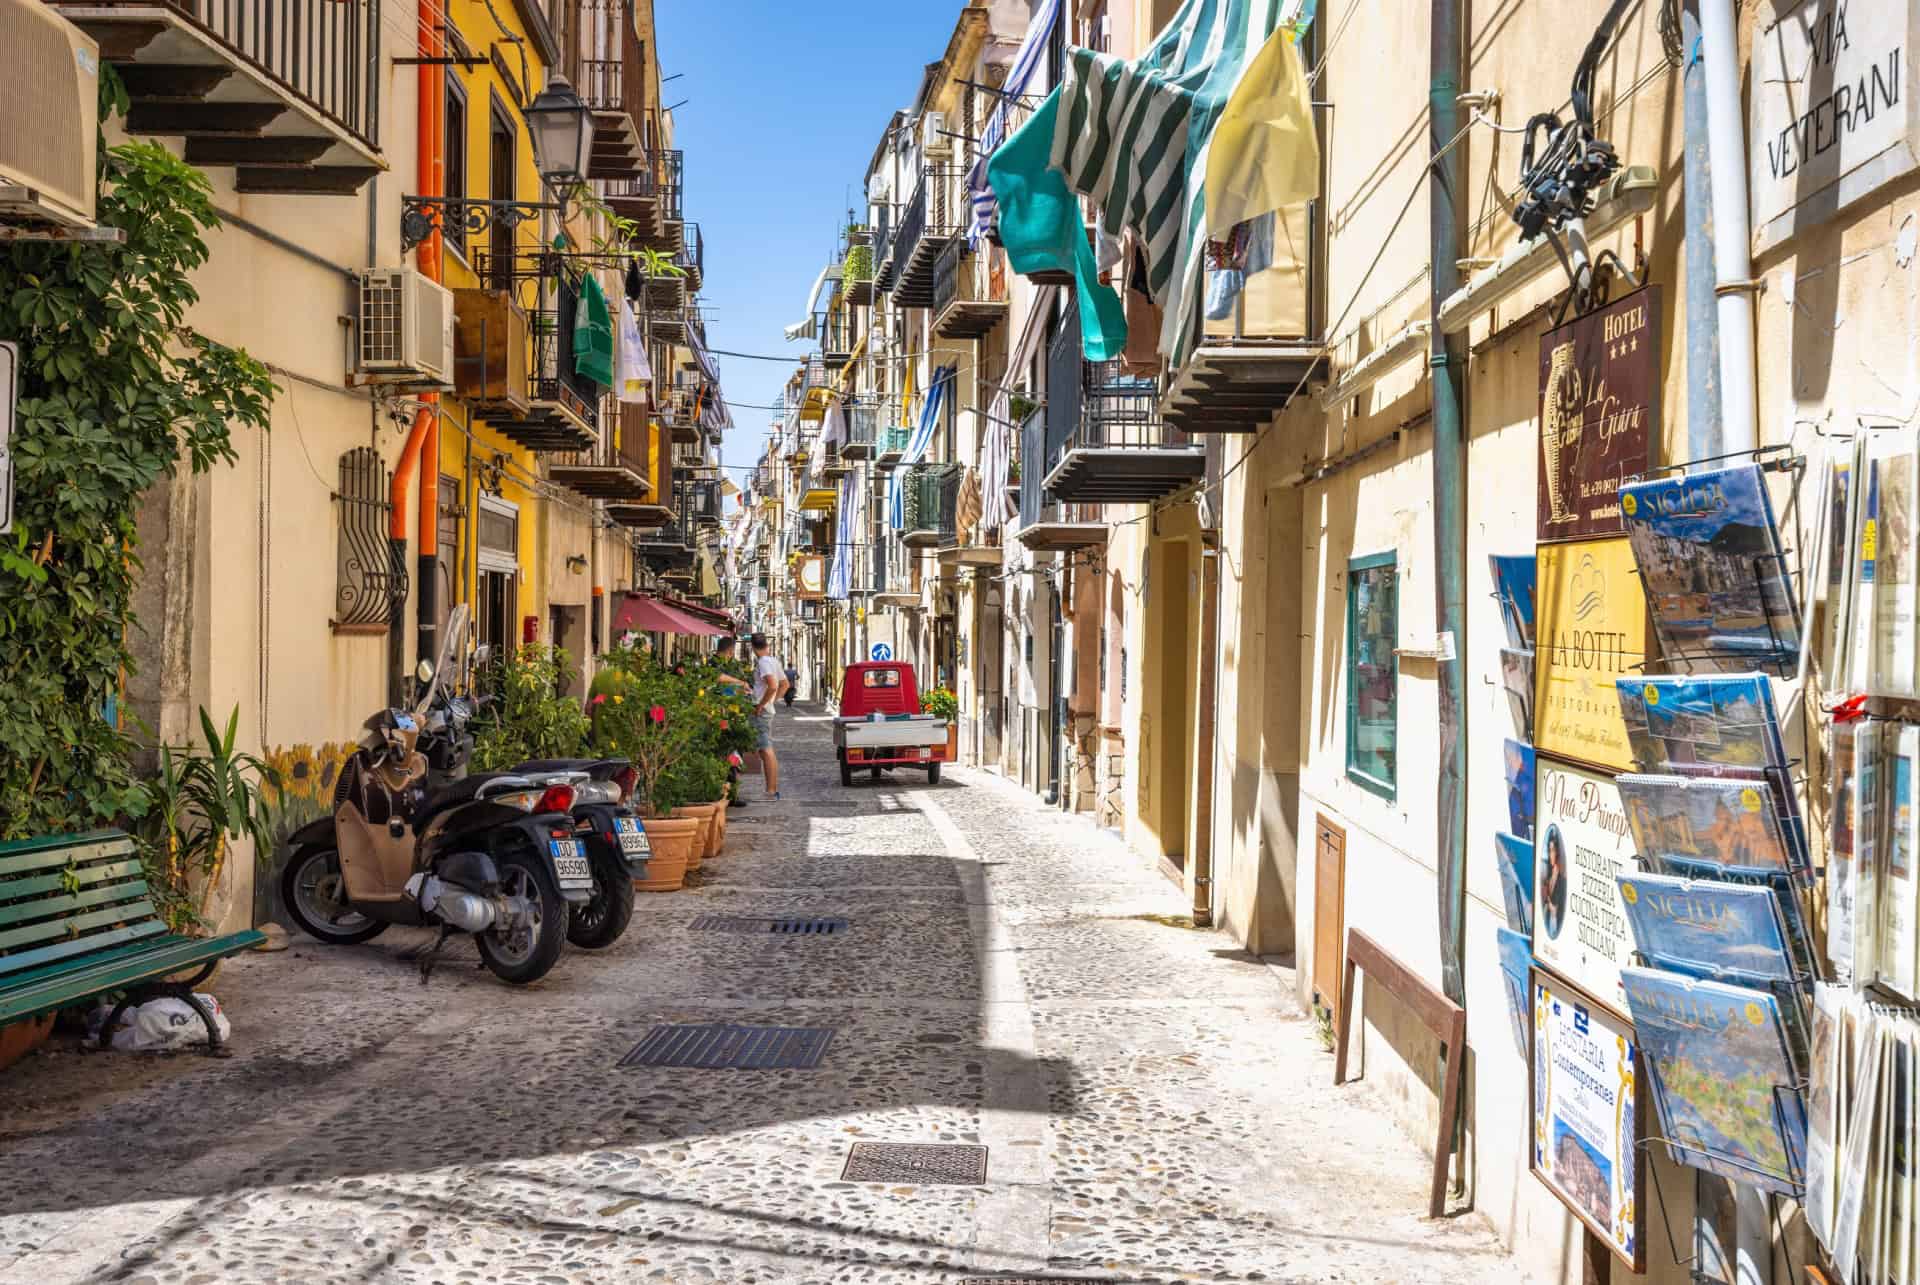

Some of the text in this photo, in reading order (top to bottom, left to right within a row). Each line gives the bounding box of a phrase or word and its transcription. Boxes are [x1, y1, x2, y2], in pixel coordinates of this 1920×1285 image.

[1808, 6, 1850, 69] VIA
[1767, 47, 1901, 181] VETERANI
[1604, 305, 1646, 344] HOTEL
[1584, 365, 1607, 408] La
[1599, 396, 1642, 457] Giara
[1643, 481, 1729, 518] SICILIA
[1551, 629, 1626, 674] LA BOTTE
[1582, 872, 1616, 909] PIZZERIA
[1645, 891, 1742, 929] SICILIA
[1569, 892, 1626, 942] CUCINA TIPICA
[1578, 920, 1617, 963] SICILIANA
[1551, 1041, 1615, 1107] Contemporanea
